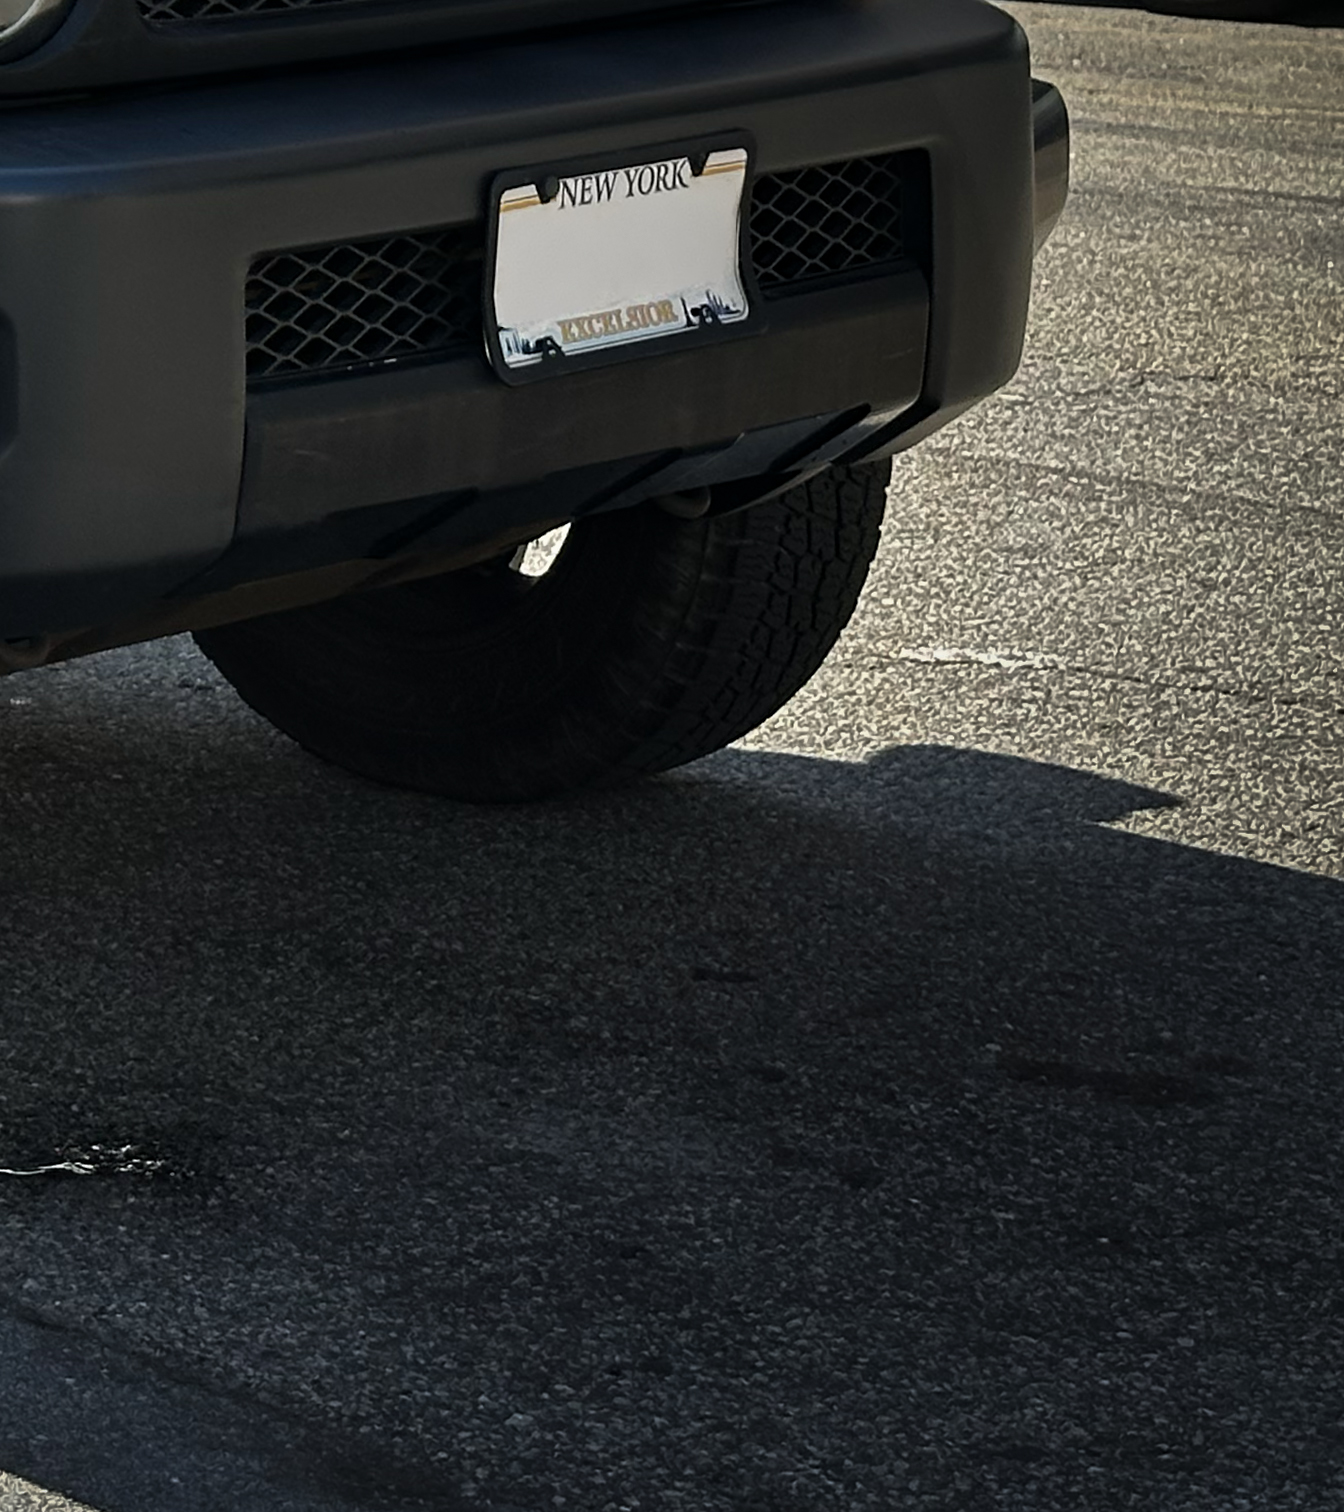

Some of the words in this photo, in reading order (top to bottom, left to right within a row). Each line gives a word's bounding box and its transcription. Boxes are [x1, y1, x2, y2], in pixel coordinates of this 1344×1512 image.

[558, 172, 616, 210] NEW
[624, 158, 690, 198] YORK
[557, 299, 679, 343] EXCELSIOR
